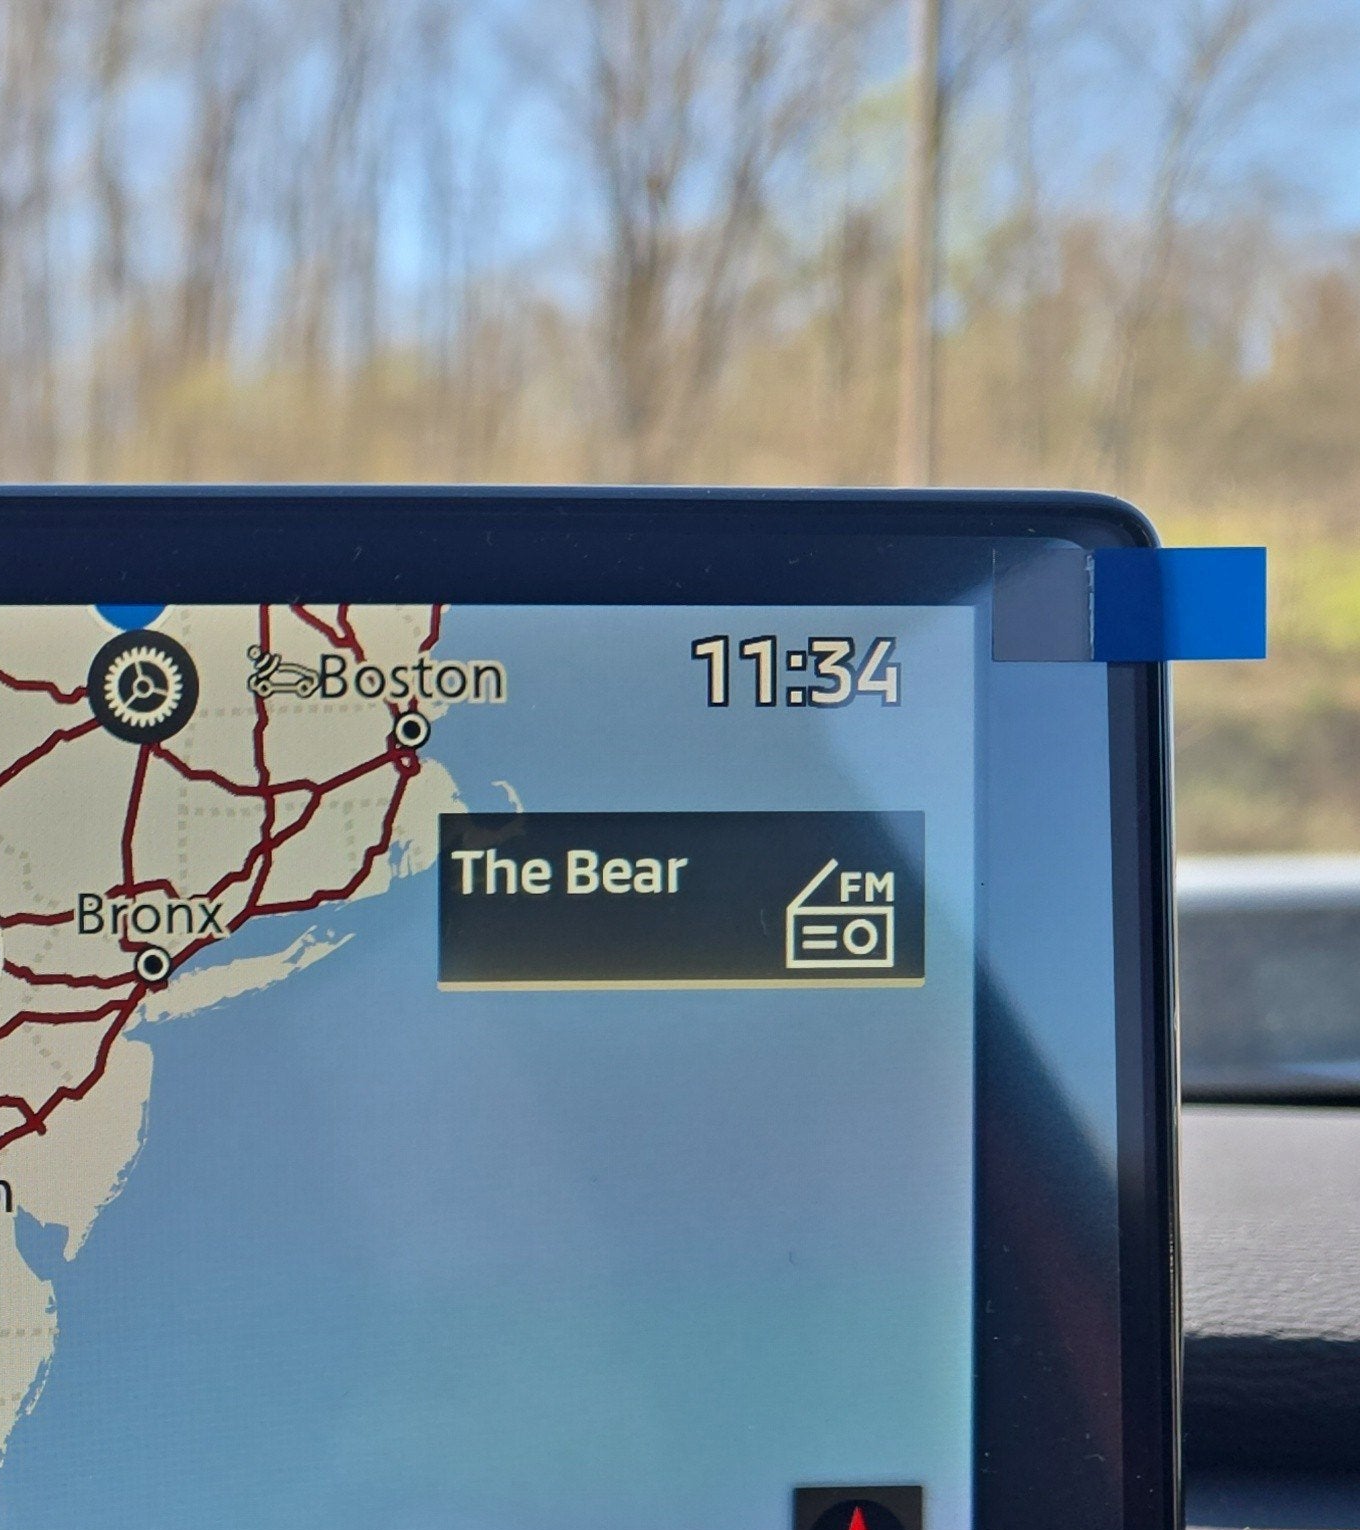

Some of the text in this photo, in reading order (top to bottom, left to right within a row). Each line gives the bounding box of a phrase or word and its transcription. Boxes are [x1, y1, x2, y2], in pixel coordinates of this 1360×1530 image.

[320, 654, 503, 700] Boston
[693, 635, 901, 706] 11:34
[452, 850, 688, 894] The Bear
[839, 873, 894, 903] FM
[79, 896, 223, 935] Bronx
